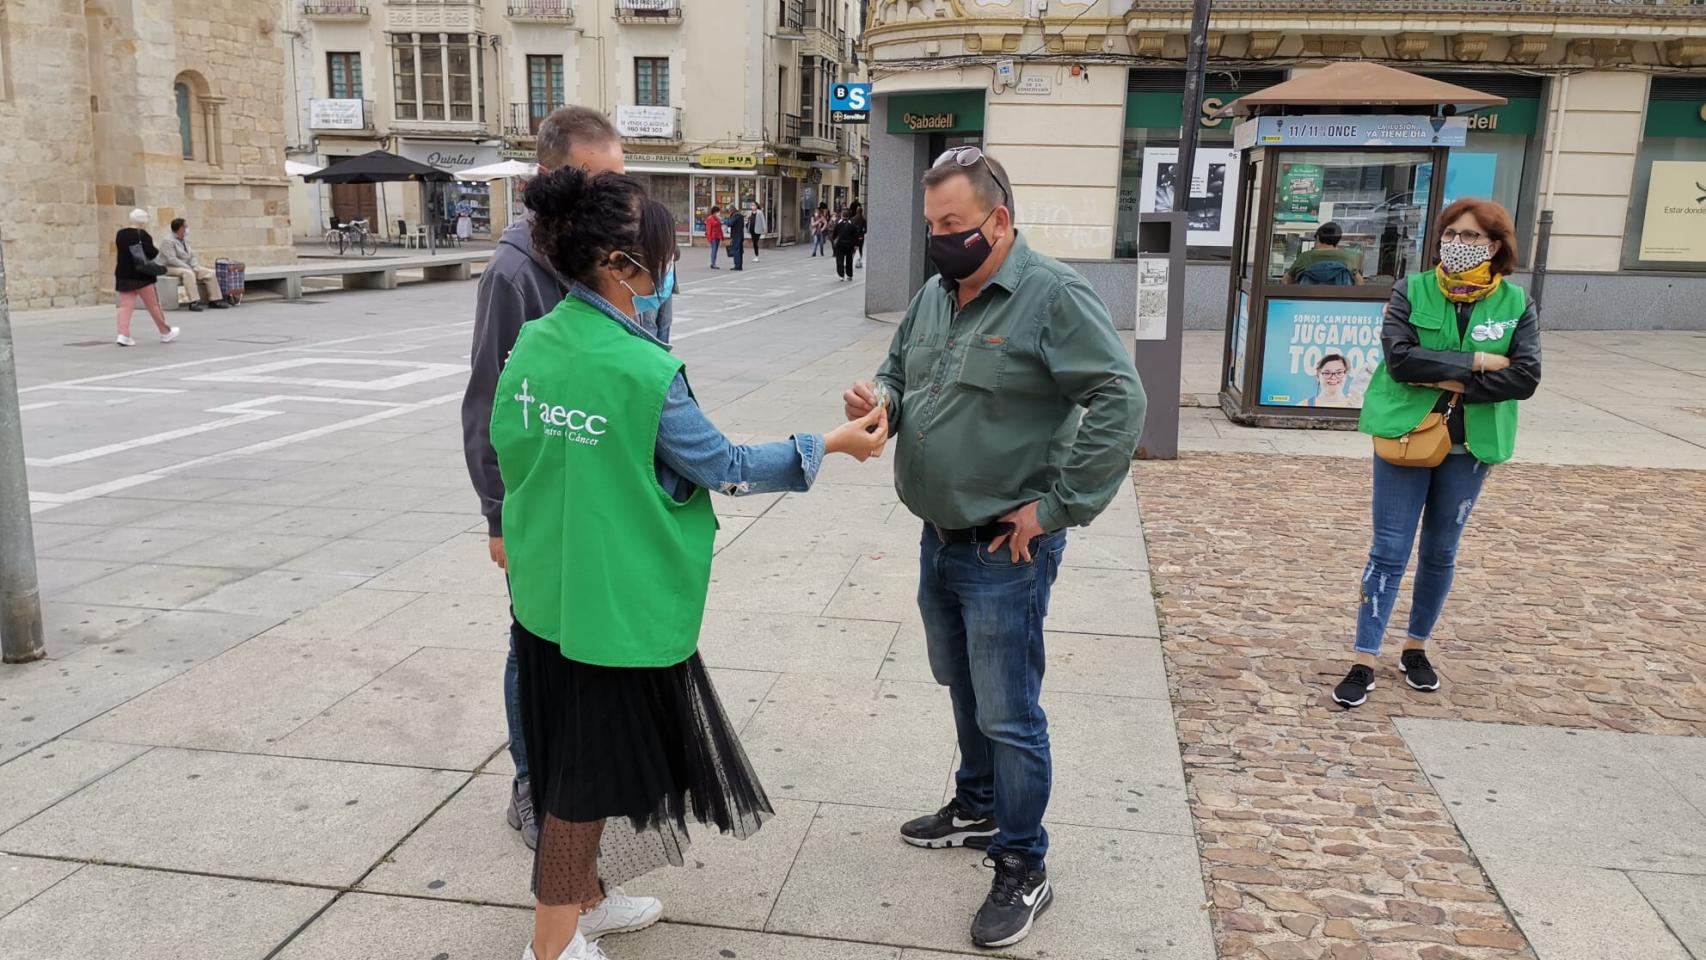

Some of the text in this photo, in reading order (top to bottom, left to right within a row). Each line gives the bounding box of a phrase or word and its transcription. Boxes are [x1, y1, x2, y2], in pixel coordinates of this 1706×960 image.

[849, 87, 865, 110] S
[1328, 125, 1357, 137] ONCE
[1380, 130, 1408, 138] TIENE
[427, 152, 476, 168] Quintas
[1293, 314, 1320, 323] SOMOS
[1323, 315, 1372, 324] CAMPEONES
[1290, 324, 1382, 346] JUGAMOS
[539, 403, 607, 435] aecc
